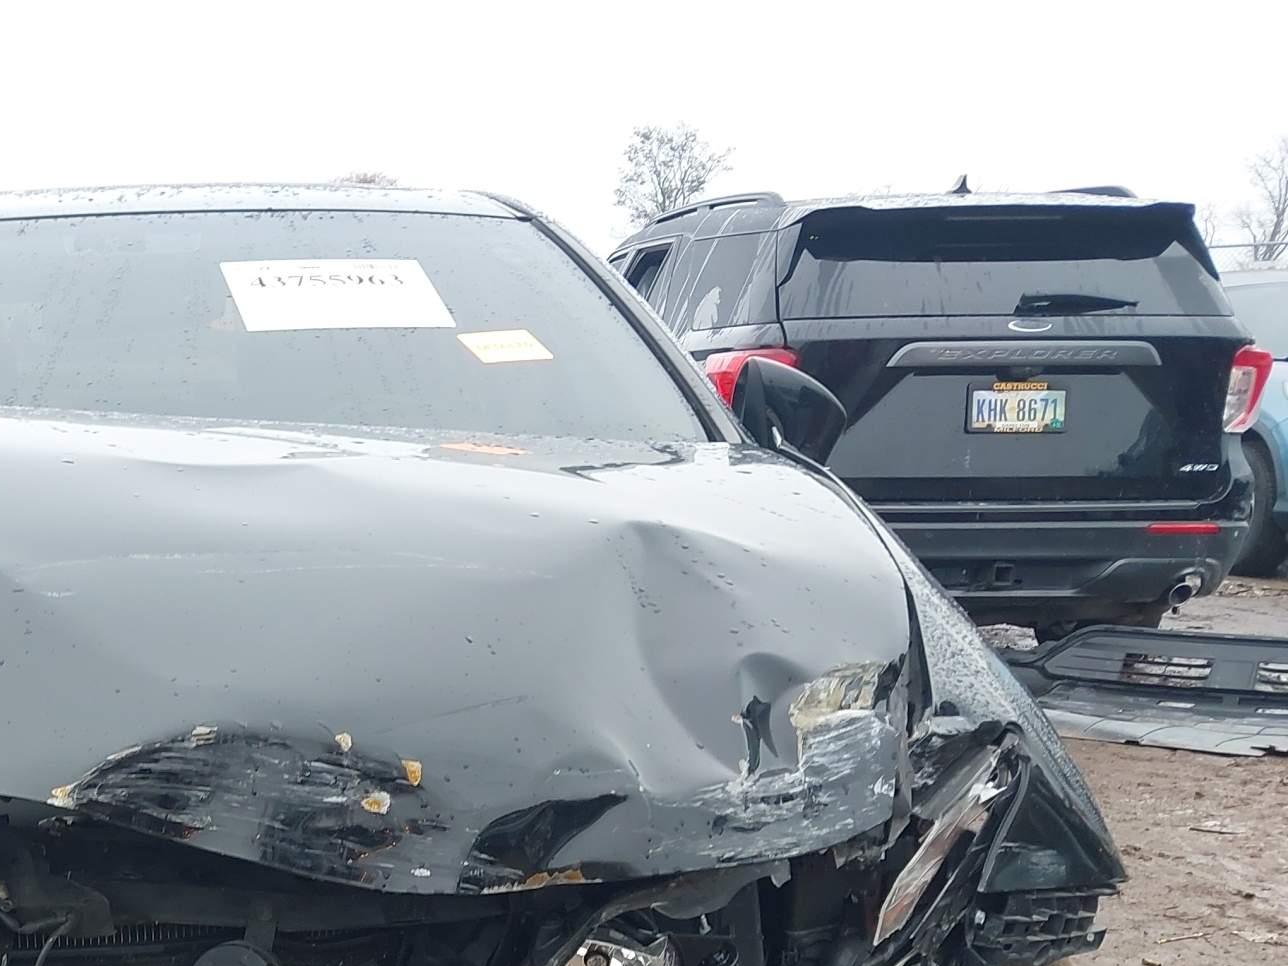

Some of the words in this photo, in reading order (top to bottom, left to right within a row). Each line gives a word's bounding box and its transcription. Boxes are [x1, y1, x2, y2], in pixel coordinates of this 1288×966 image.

[250, 273, 406, 288] 43755963
[937, 348, 1119, 361] EXPLORER
[992, 382, 1048, 391] CASTRUCCI
[975, 398, 1009, 422] KHK
[1016, 398, 1058, 422] 8671
[1179, 463, 1219, 472] 4WD
